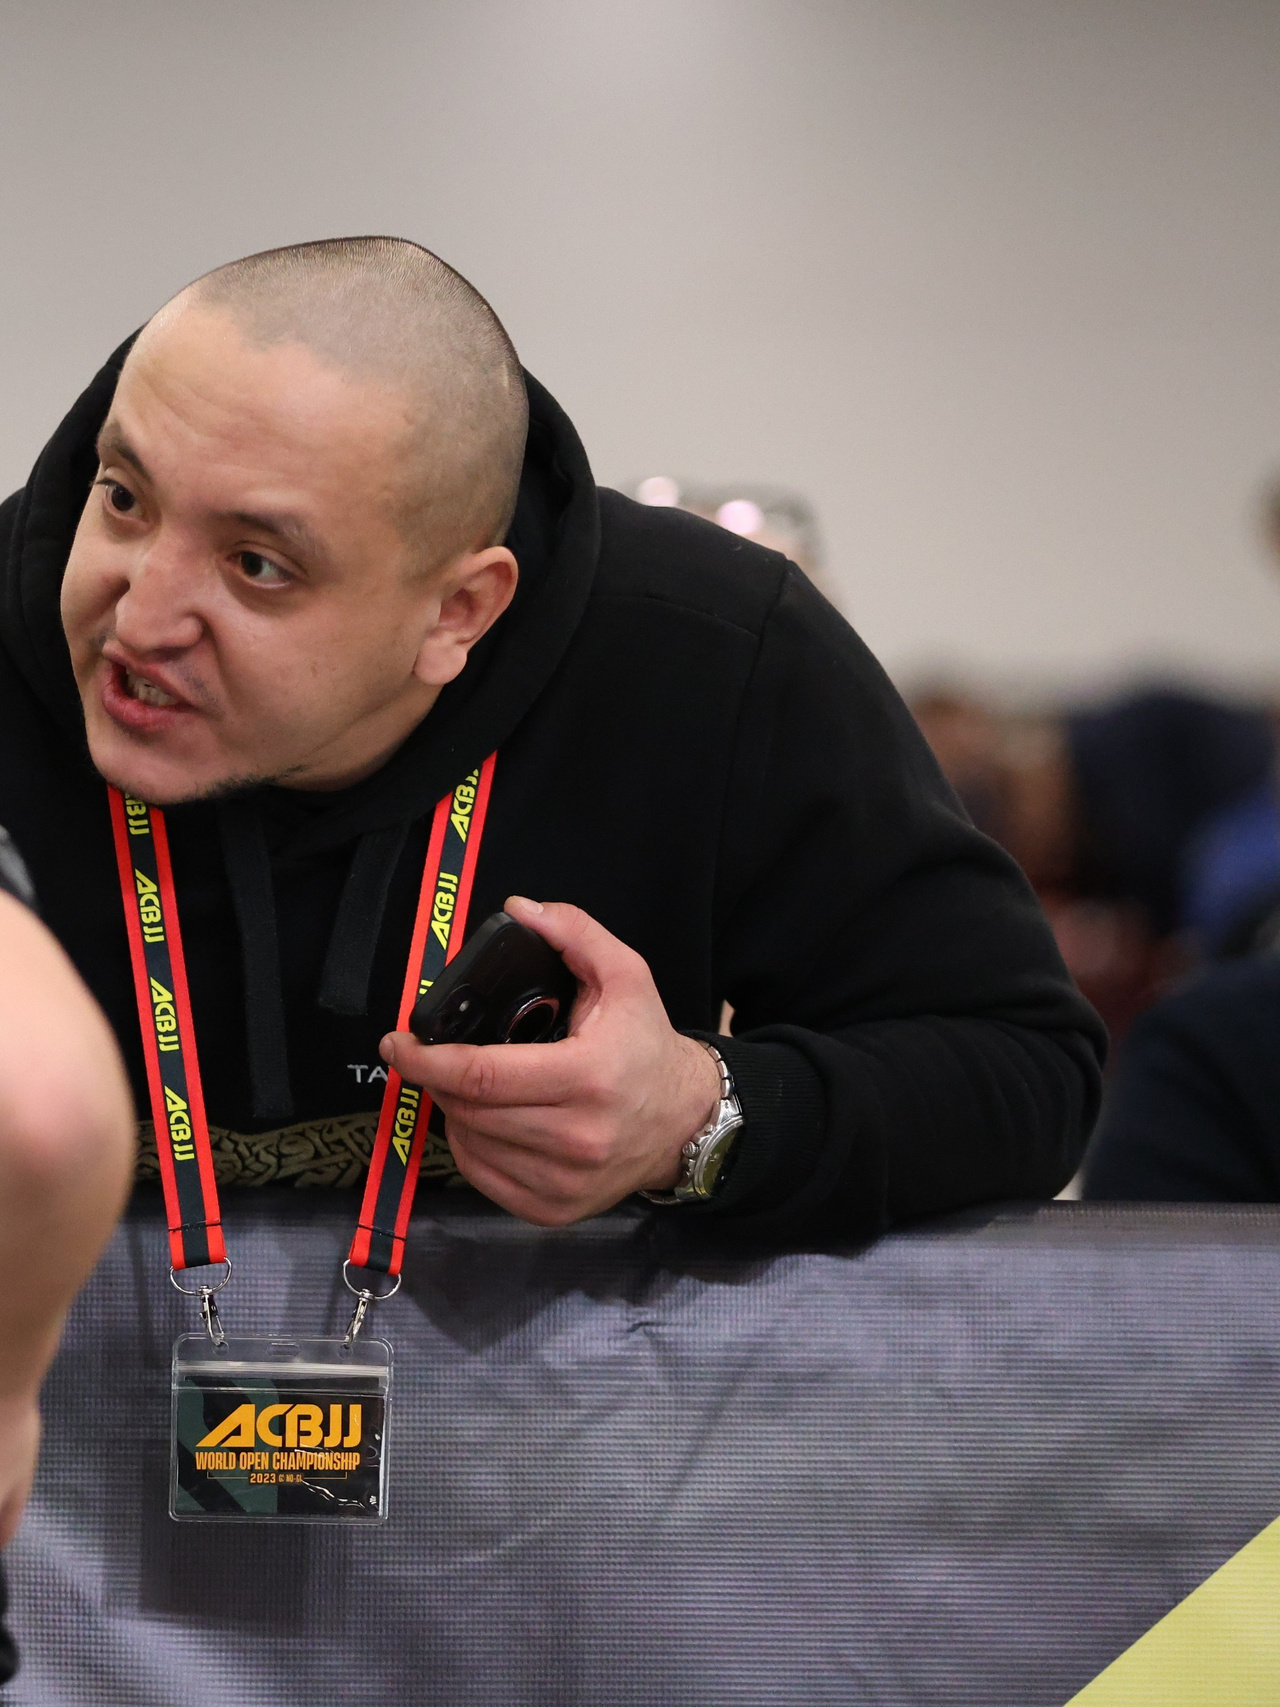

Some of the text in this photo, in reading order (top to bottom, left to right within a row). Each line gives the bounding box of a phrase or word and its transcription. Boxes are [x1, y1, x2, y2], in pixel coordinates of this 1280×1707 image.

[125, 793, 150, 835] BJJ
[450, 768, 479, 843] ACBJ
[135, 869, 165, 943] ACBJJ
[429, 871, 458, 950] ACBJJ
[150, 977, 180, 1052] ACBJJ
[164, 1086, 195, 1161] ACBJJ
[391, 1087, 419, 1166] ACBJJ
[195, 1403, 362, 1448] ACBJJ
[195, 1451, 361, 1471] WORLD OPEN CHAMPIONSHIP
[250, 1472, 276, 1484] 2023
